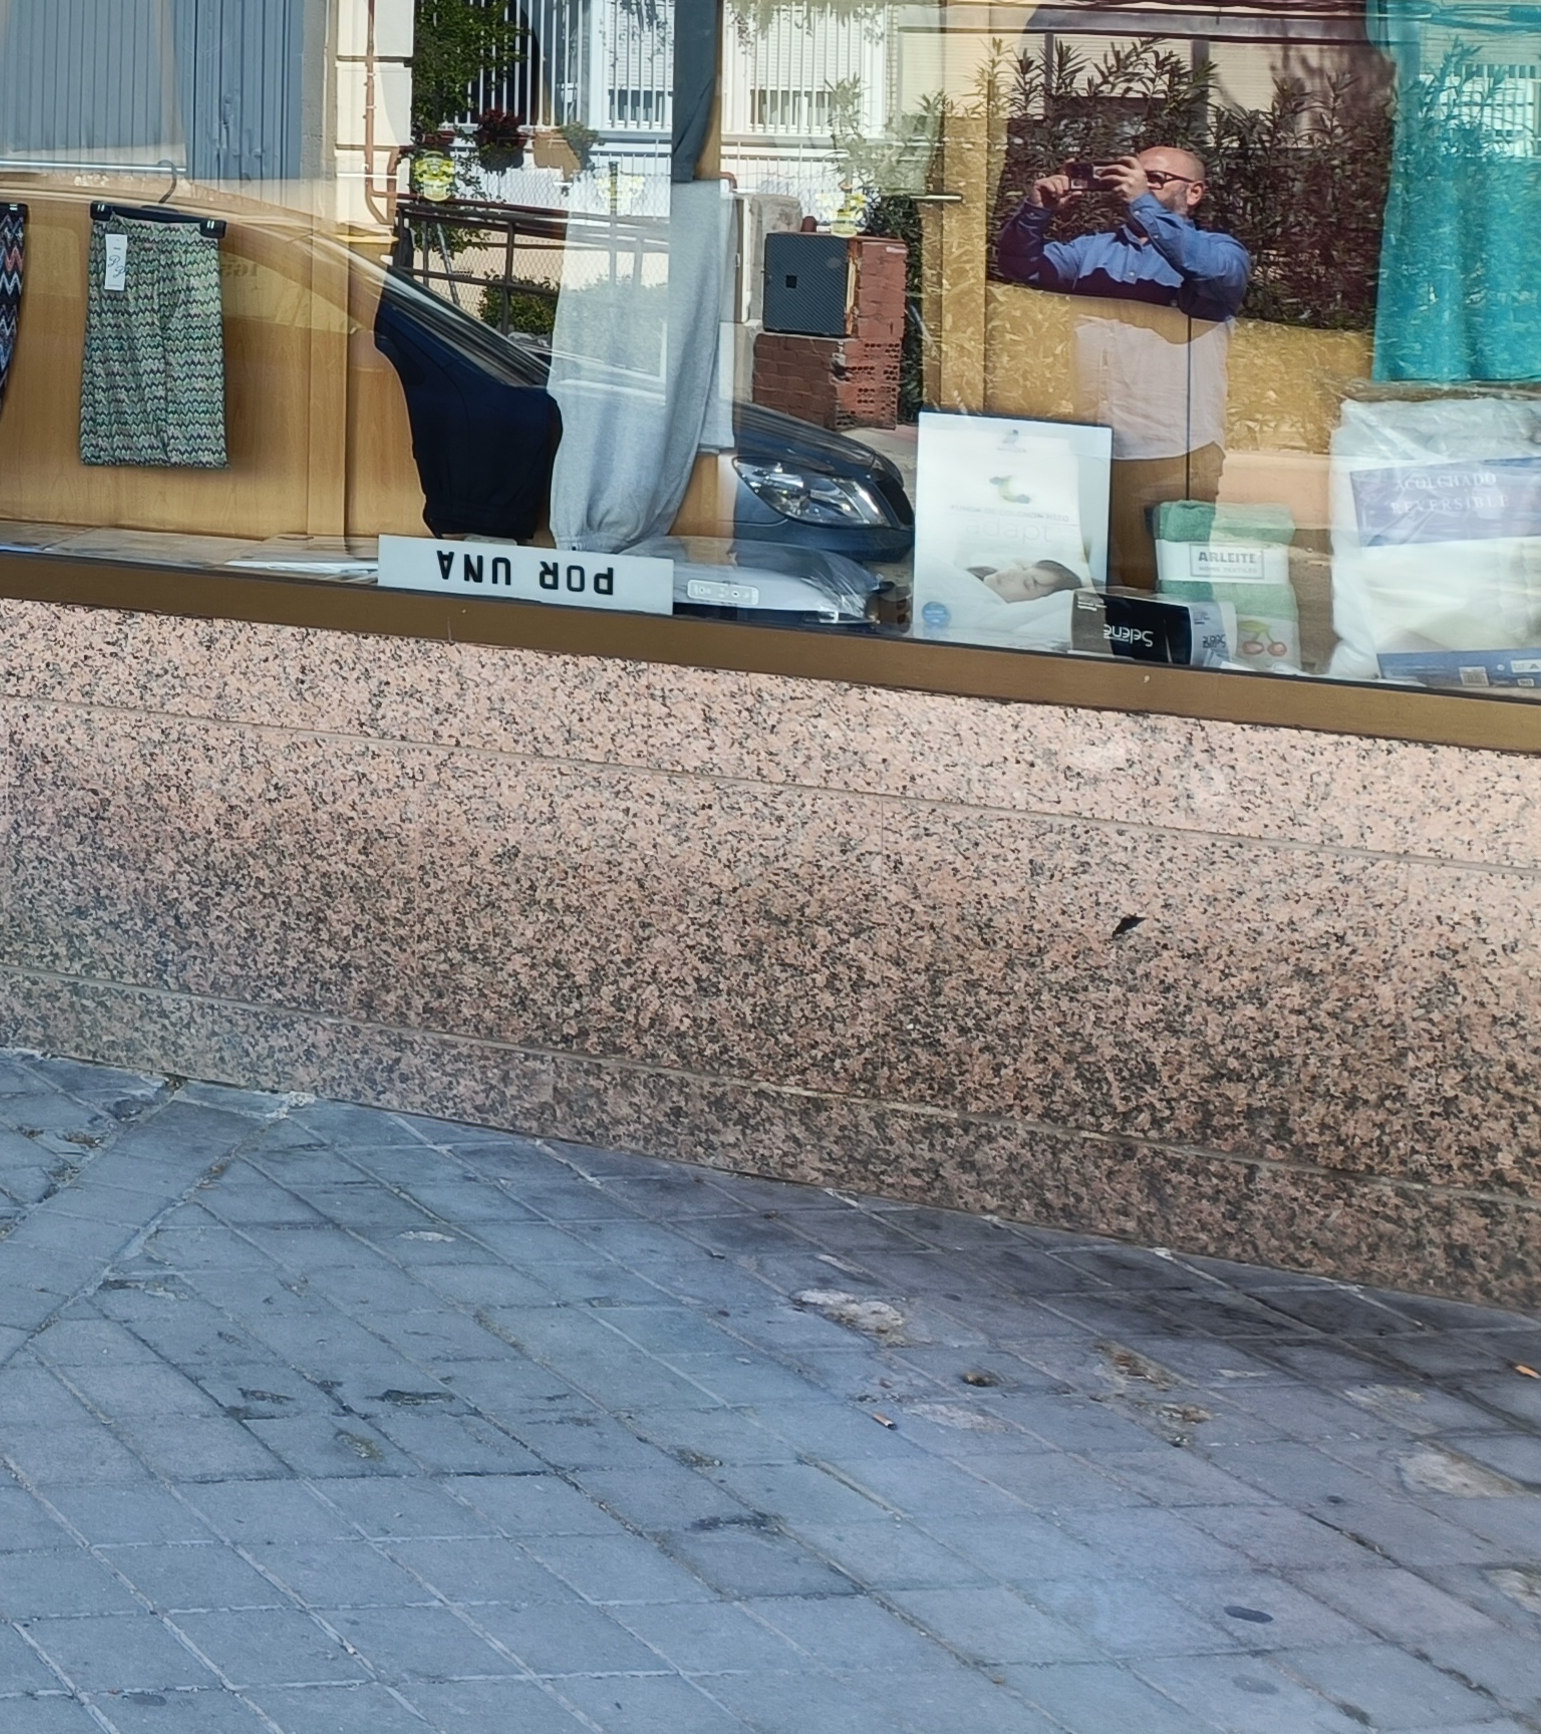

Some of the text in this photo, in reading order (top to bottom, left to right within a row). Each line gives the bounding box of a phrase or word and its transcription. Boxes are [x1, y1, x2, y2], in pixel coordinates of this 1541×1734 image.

[1395, 472, 1497, 492] ACOLCHADO
[965, 518, 1052, 545] adapt
[1198, 551, 1257, 564] ARLEITE
[436, 550, 614, 595] POR UNA
